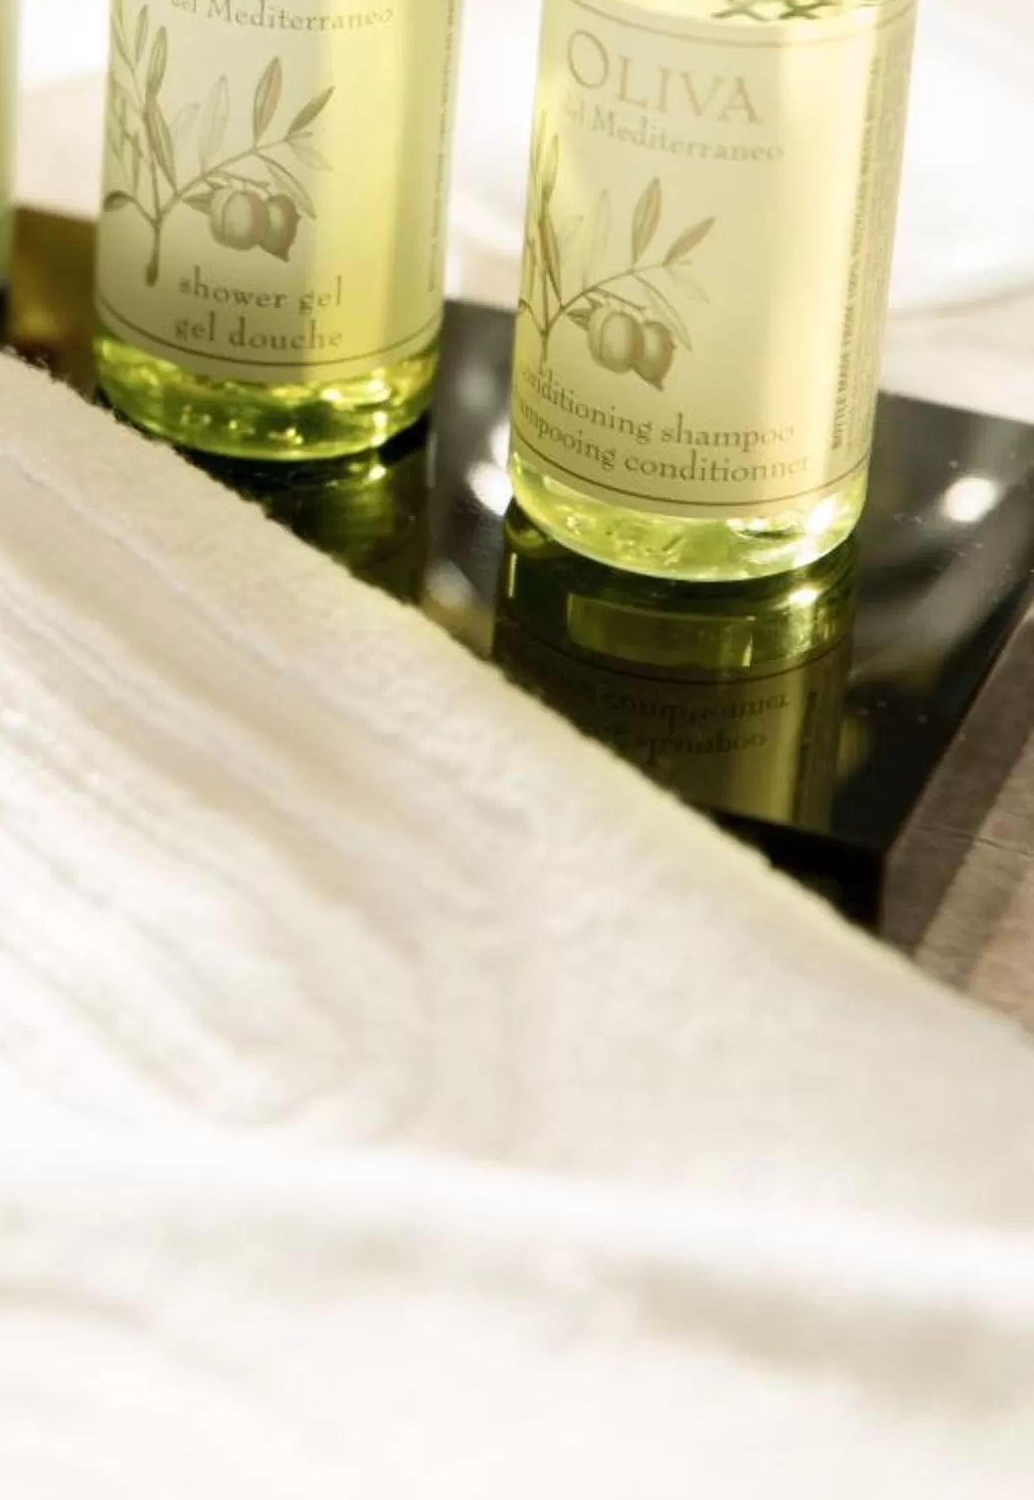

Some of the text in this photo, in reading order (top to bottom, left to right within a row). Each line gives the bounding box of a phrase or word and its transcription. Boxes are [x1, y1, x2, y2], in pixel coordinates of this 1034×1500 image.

[567, 28, 764, 126] OLIVA
[179, 264, 343, 317] shower gel
[173, 311, 344, 351] gel douche
[521, 368, 653, 442] nditioning
[660, 411, 795, 453] shampoo
[622, 448, 812, 483] conditionner
